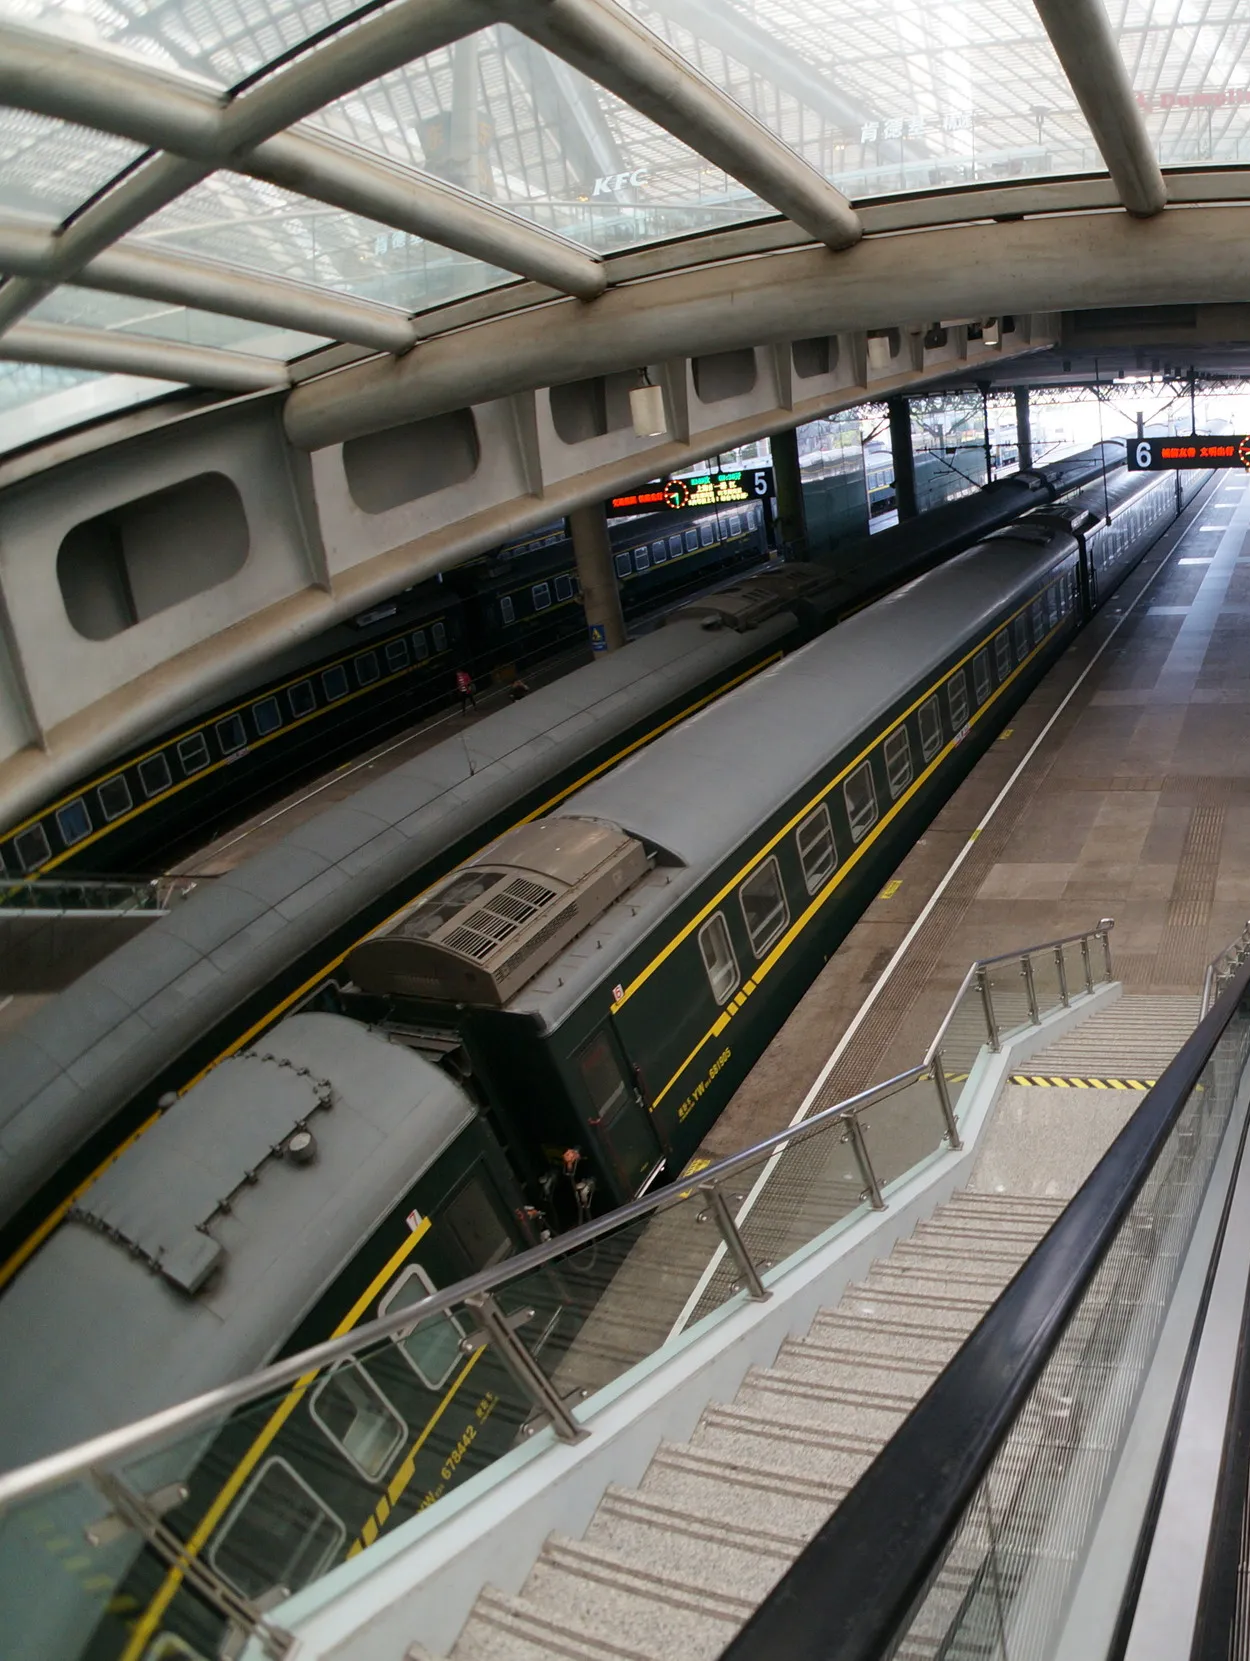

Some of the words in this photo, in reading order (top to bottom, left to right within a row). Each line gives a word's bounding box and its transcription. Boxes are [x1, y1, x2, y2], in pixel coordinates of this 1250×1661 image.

[860, 114, 925, 144] 肯德基
[592, 168, 649, 196] KFC
[1135, 441, 1152, 468] 6
[754, 471, 768, 495] 5
[440, 1424, 478, 1481] 678442
